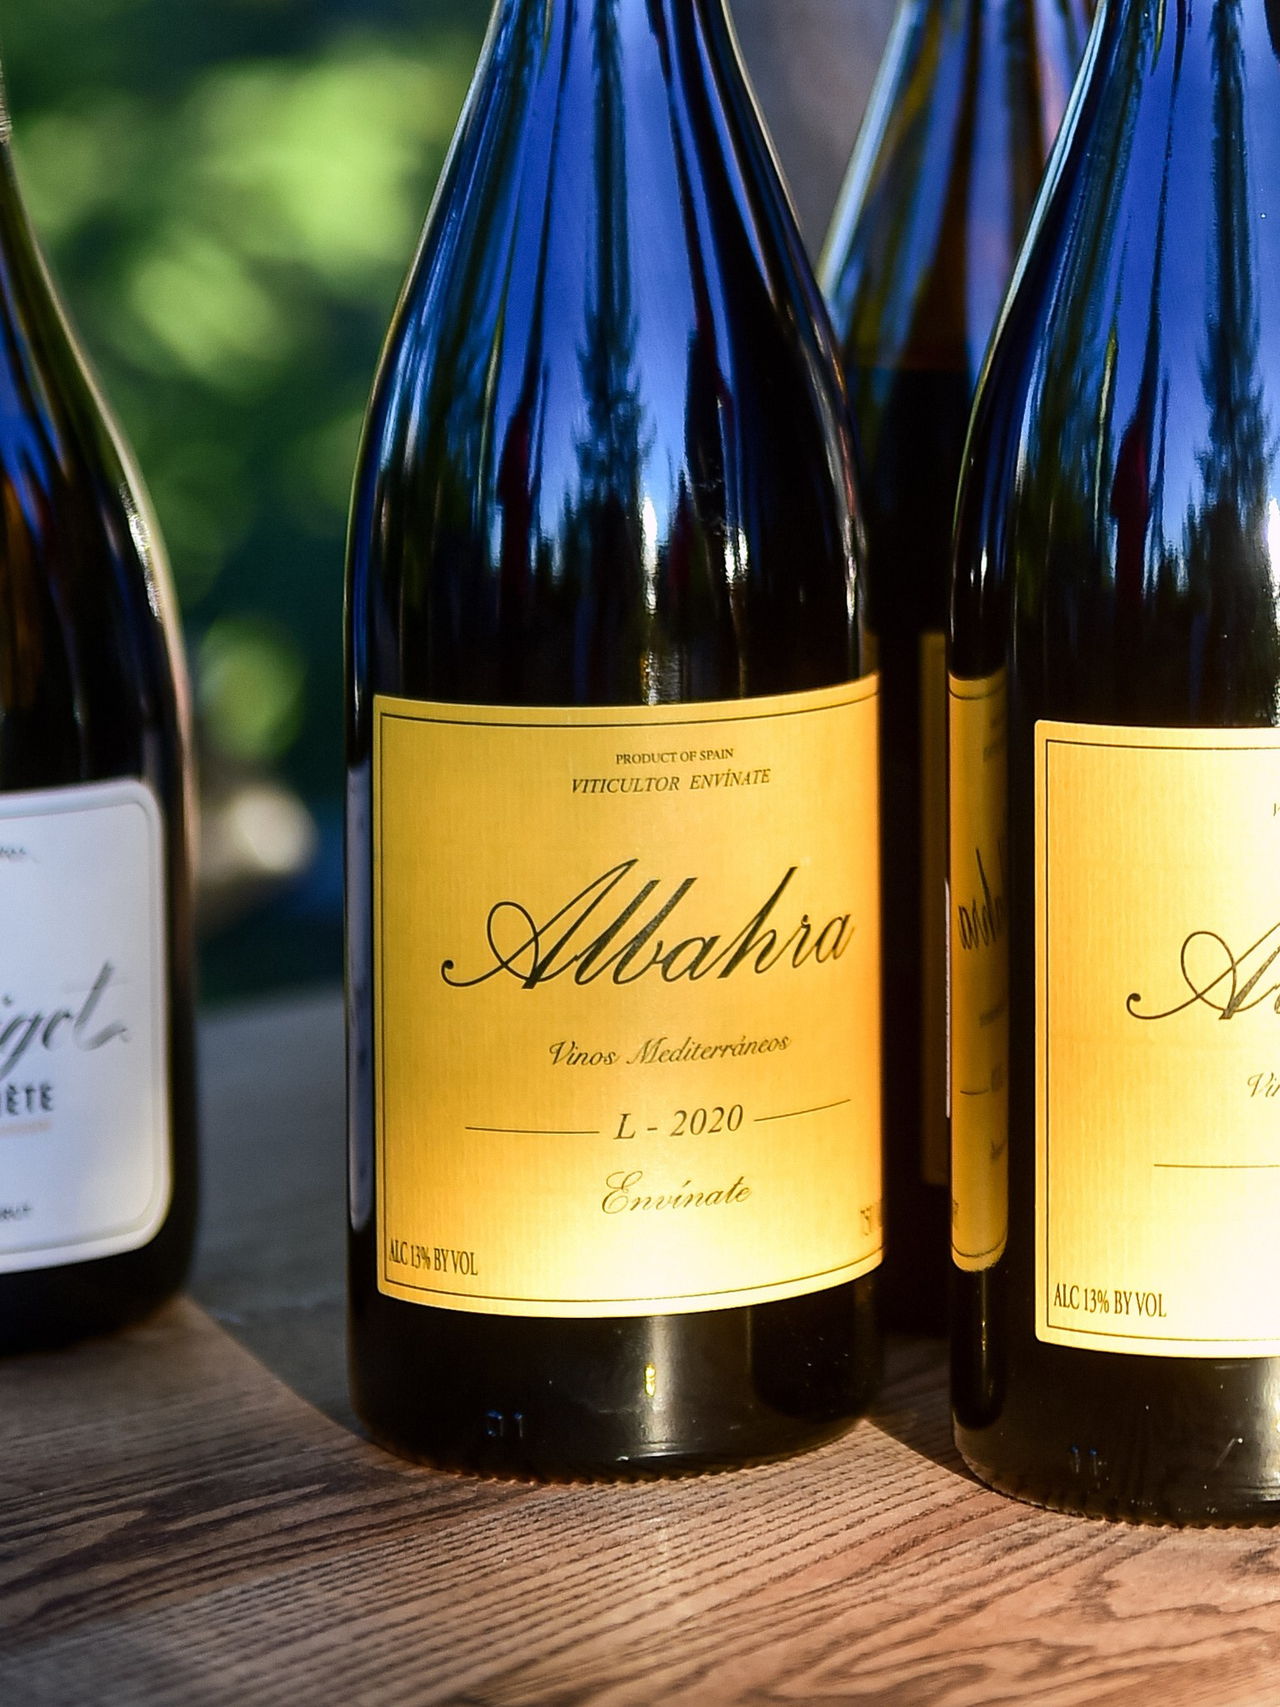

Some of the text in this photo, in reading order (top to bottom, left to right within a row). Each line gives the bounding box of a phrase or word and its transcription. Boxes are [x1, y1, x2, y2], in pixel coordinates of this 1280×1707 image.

[615, 747, 735, 765] PRODUCT OF SPAIN
[571, 768, 772, 794] VITICULTOR ENVÍNATE
[441, 858, 855, 990] Albahra
[549, 1034, 792, 1066] Vinos Mediterráneos
[613, 1113, 636, 1140] L
[669, 1104, 744, 1138] 2020
[601, 1170, 752, 1215] Envínate
[389, 1238, 479, 1276] ALC 13% BY VOL
[1053, 1282, 1167, 1318] ALC 13% BY VOL
